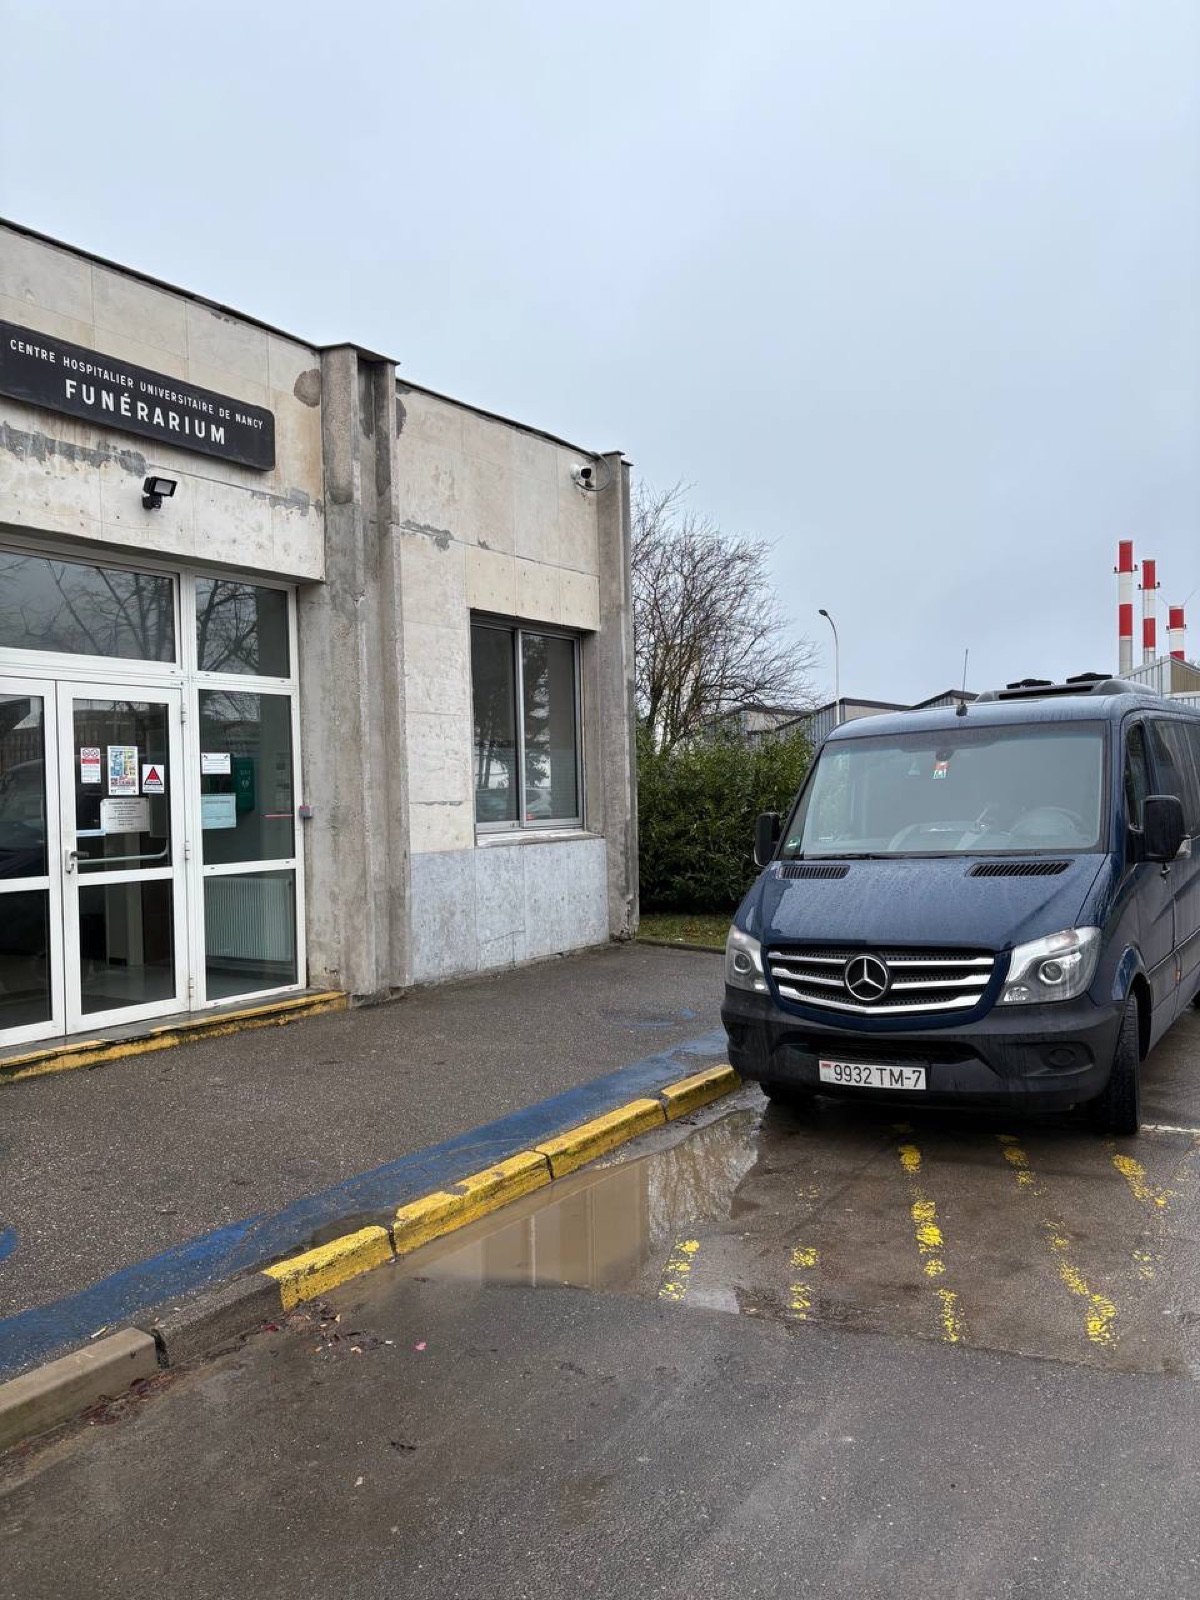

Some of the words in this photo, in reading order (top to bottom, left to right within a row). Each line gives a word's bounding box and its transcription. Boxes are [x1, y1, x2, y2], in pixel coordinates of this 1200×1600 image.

[10, 339, 56, 364] CENTRE
[63, 355, 134, 388] HOSPITALIER
[140, 380, 214, 415] UNIVERSITAIRE
[219, 407, 231, 420] DE
[235, 413, 264, 430] NANCY
[65, 379, 225, 445] FUNÉRARIUM
[834, 1064, 872, 1085] 9932
[875, 1068, 922, 1088] TM-7
